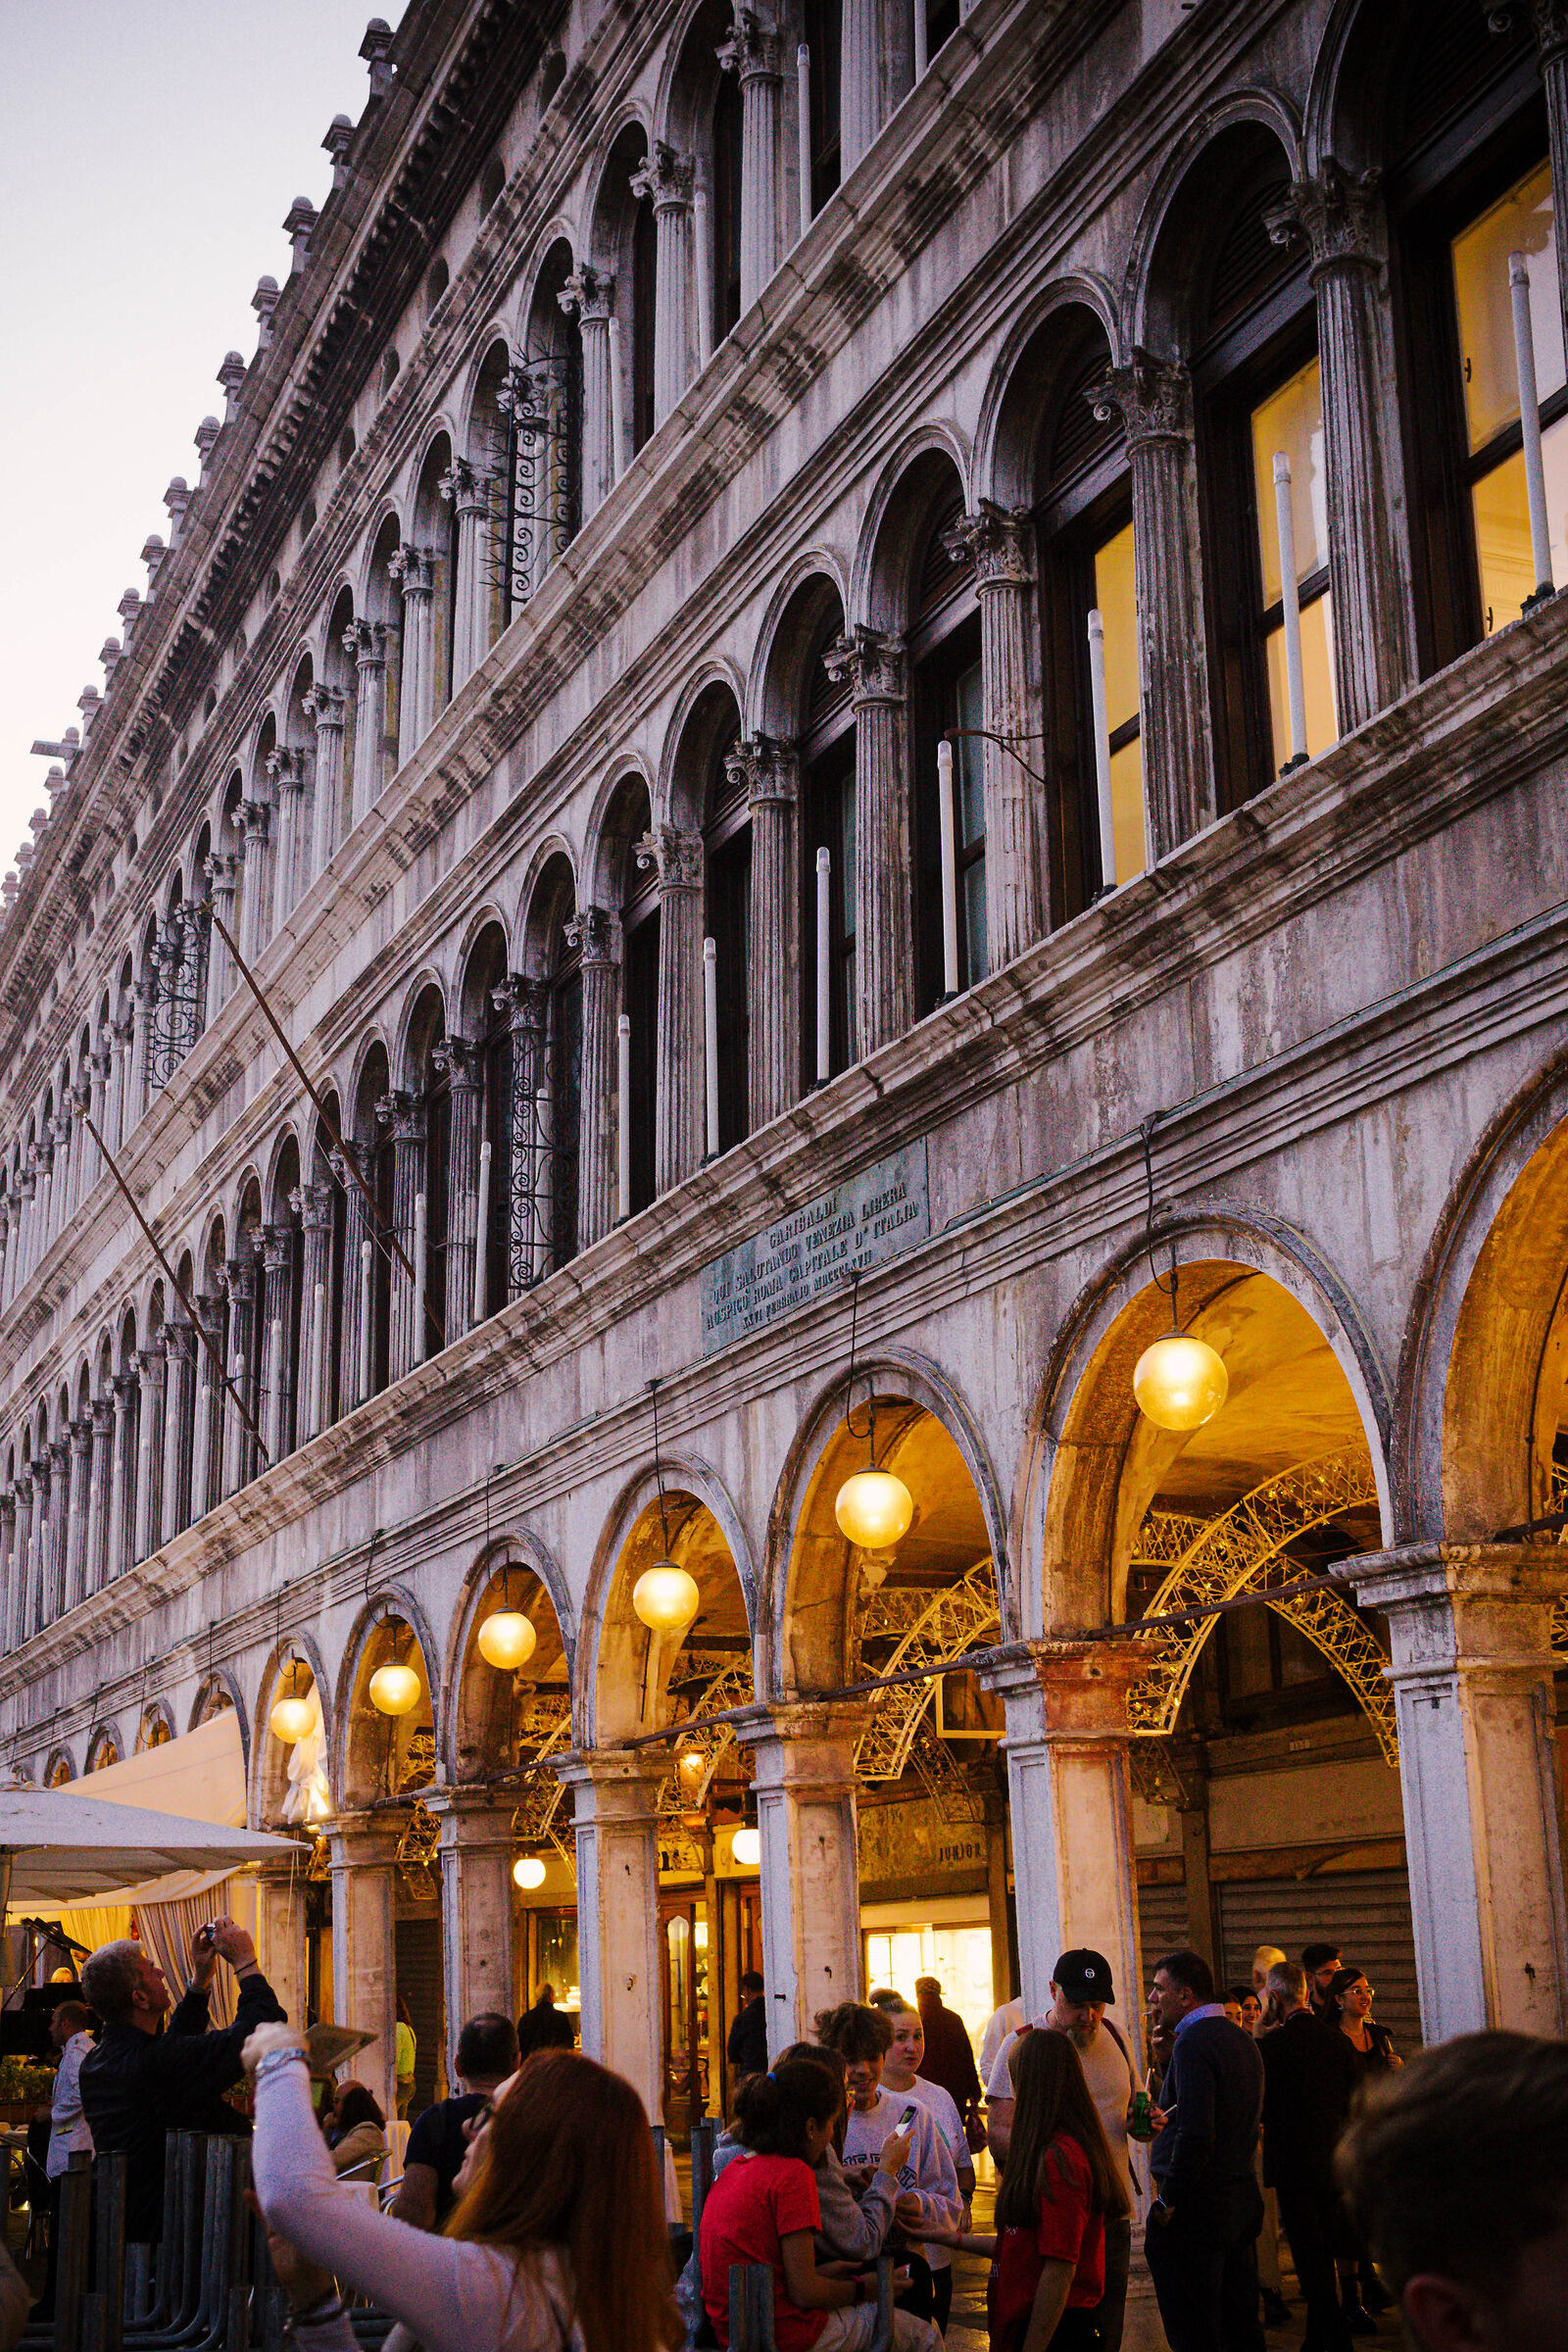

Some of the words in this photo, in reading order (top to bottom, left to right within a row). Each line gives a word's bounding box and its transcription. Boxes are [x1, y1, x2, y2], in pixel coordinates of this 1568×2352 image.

[713, 1282, 730, 1304] QUI
[735, 1244, 798, 1292] SALUTANDO
[806, 1211, 856, 1251] VENEZIA
[861, 1182, 906, 1222] LIBERA
[769, 1198, 837, 1249] GARIBALDI
[754, 1276, 783, 1304] ROMA
[789, 1239, 848, 1283] CAPITALE
[939, 1843, 981, 1862] JUNIOR
